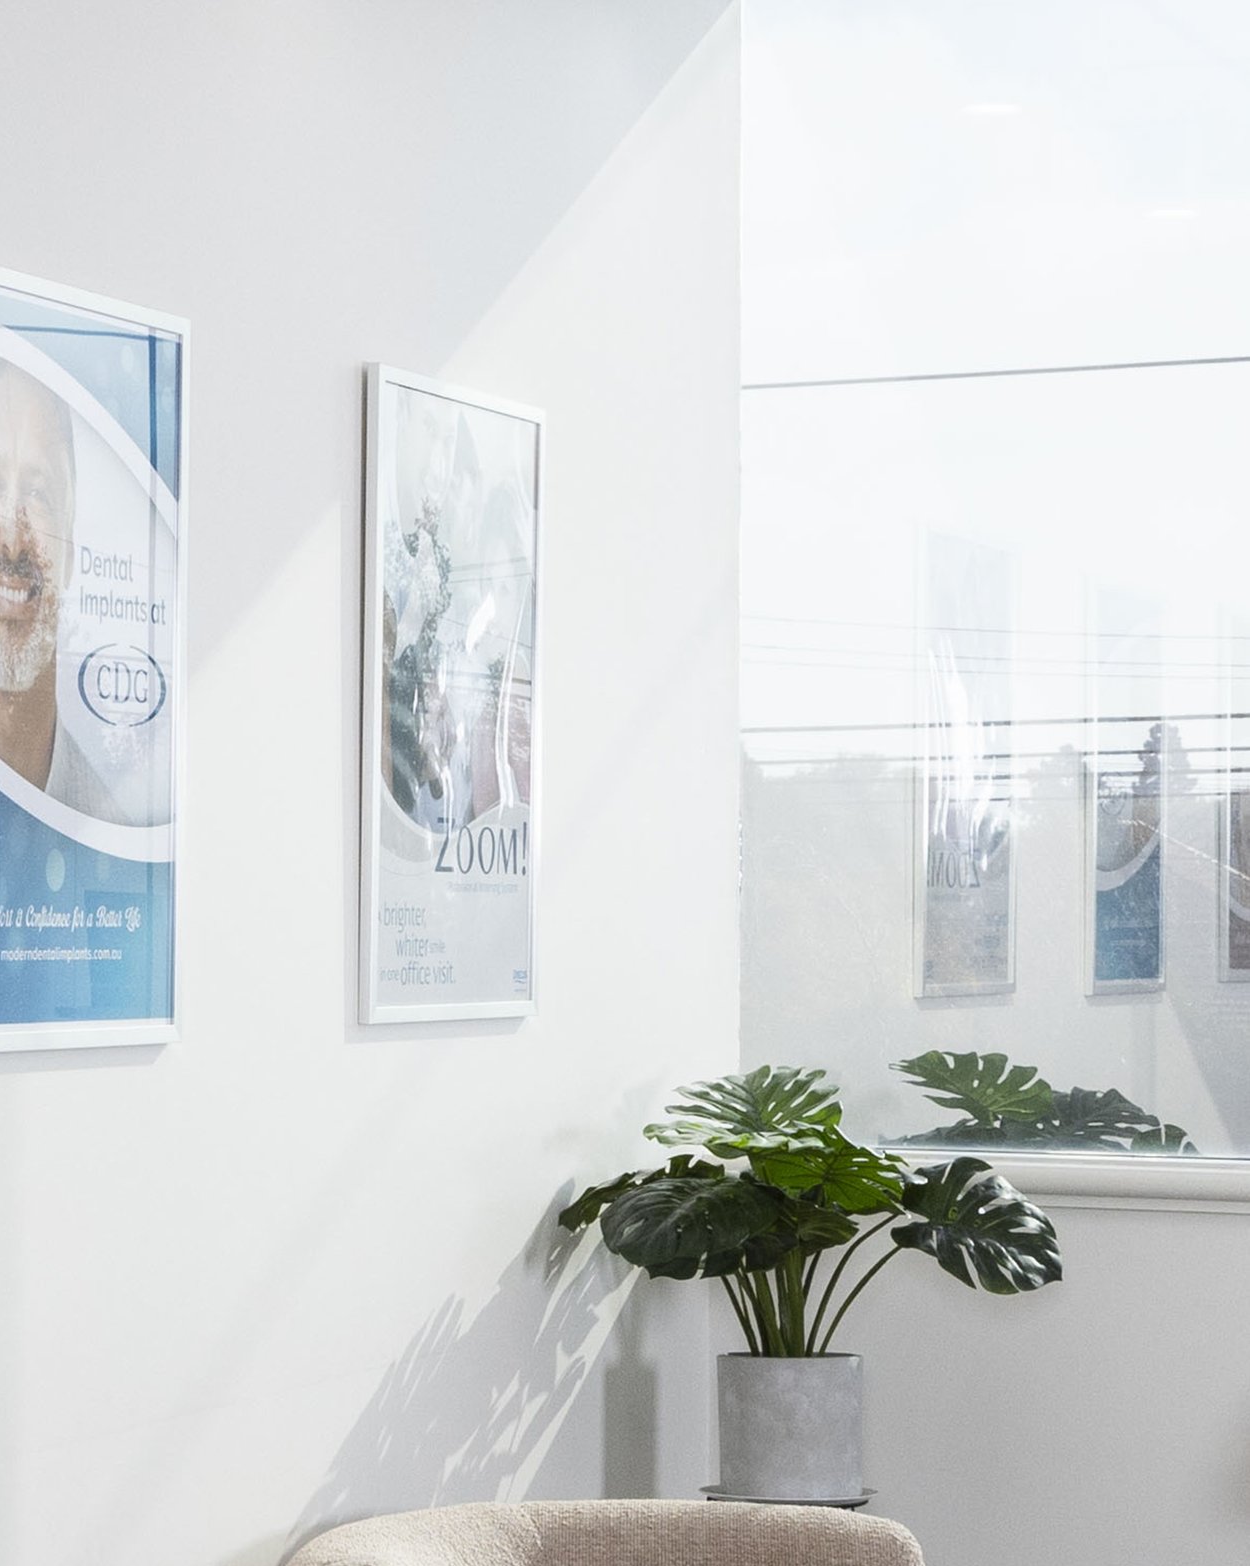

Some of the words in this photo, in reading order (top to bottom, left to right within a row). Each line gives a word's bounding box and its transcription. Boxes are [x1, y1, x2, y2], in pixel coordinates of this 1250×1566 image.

[80, 546, 134, 583] Dental
[79, 586, 148, 624] Implants
[151, 599, 166, 626] at
[96, 661, 149, 704] CDG
[435, 816, 527, 876] ZOOM!
[25, 904, 70, 933] Confidence
[71, 905, 84, 932] for
[86, 913, 93, 928] a
[96, 905, 123, 928] Better
[124, 906, 141, 932] Life
[0, 946, 122, 963] moderndentalimplants.com.au
[396, 933, 429, 957] whiter
[400, 961, 430, 985] office
